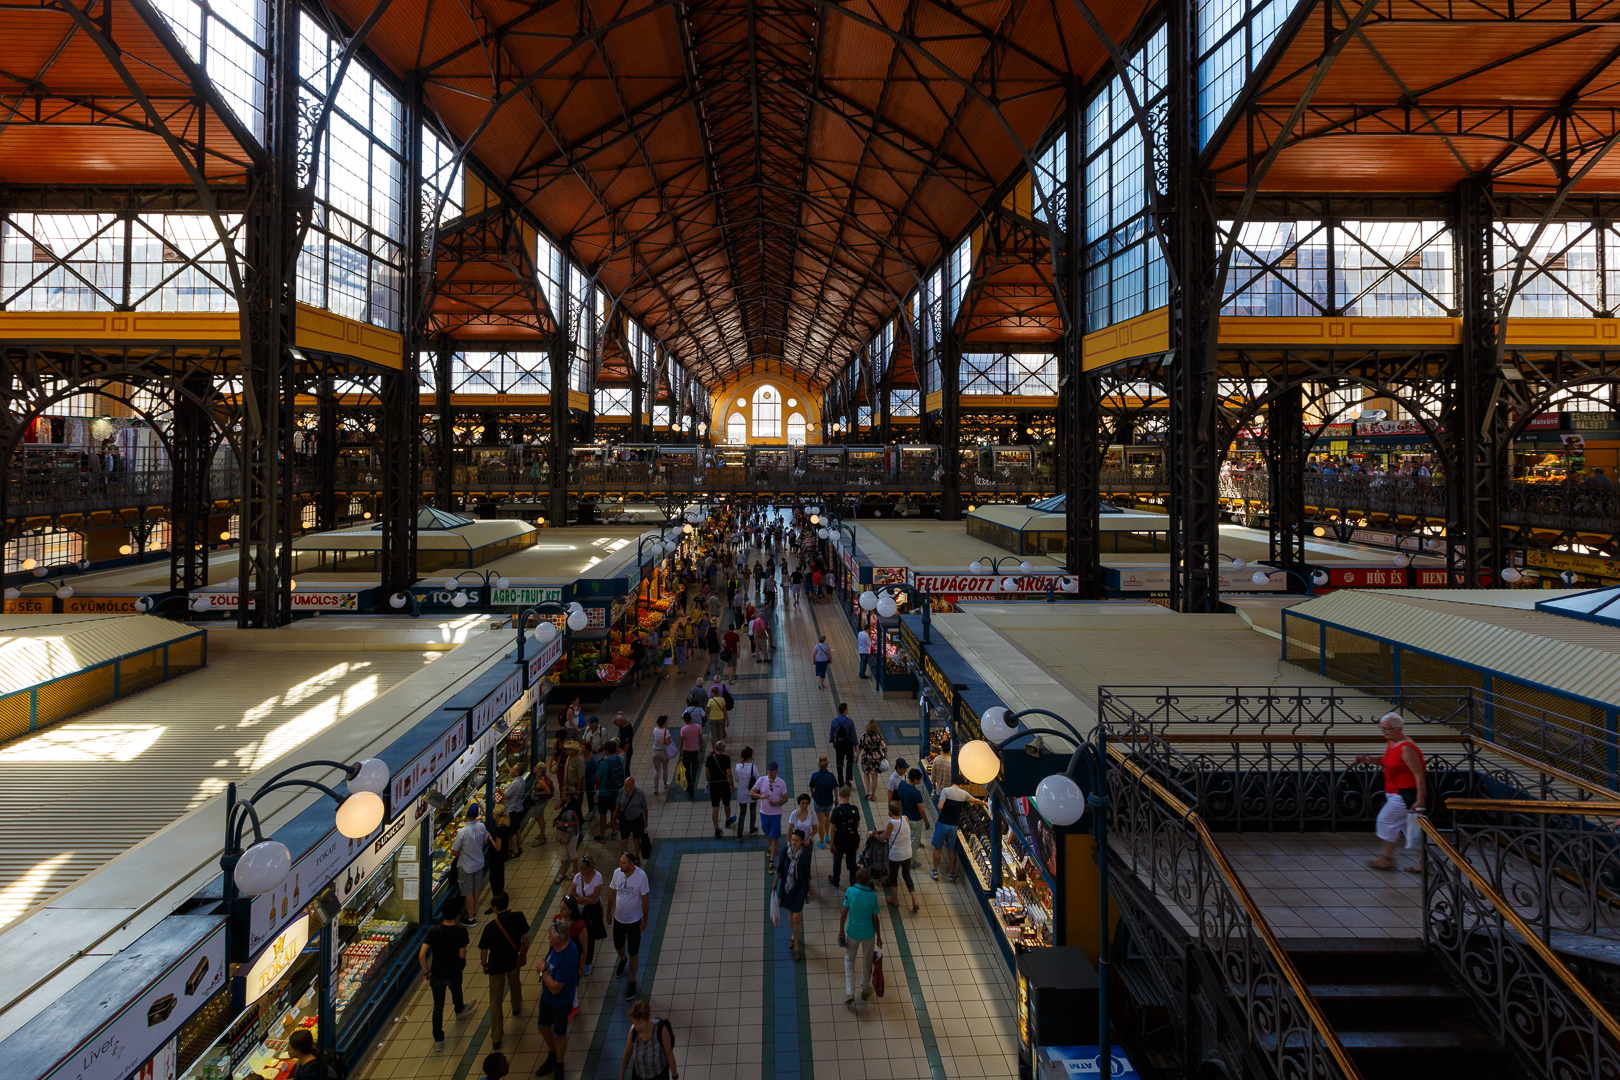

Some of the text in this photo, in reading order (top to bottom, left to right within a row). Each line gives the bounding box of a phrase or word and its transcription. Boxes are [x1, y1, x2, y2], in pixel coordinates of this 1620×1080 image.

[917, 575, 996, 592] FELVÁGOTT
[1366, 570, 1402, 585] HÚS ÉS
[432, 588, 480, 604] TOS
[493, 588, 544, 604] AGRO-FRUIT
[380, 817, 406, 846] UNICUM
[315, 842, 337, 866] TOKAJI
[258, 940, 297, 989] TOKAJI
[83, 1034, 116, 1071] Liver
[1069, 1061, 1093, 1070] ATM
